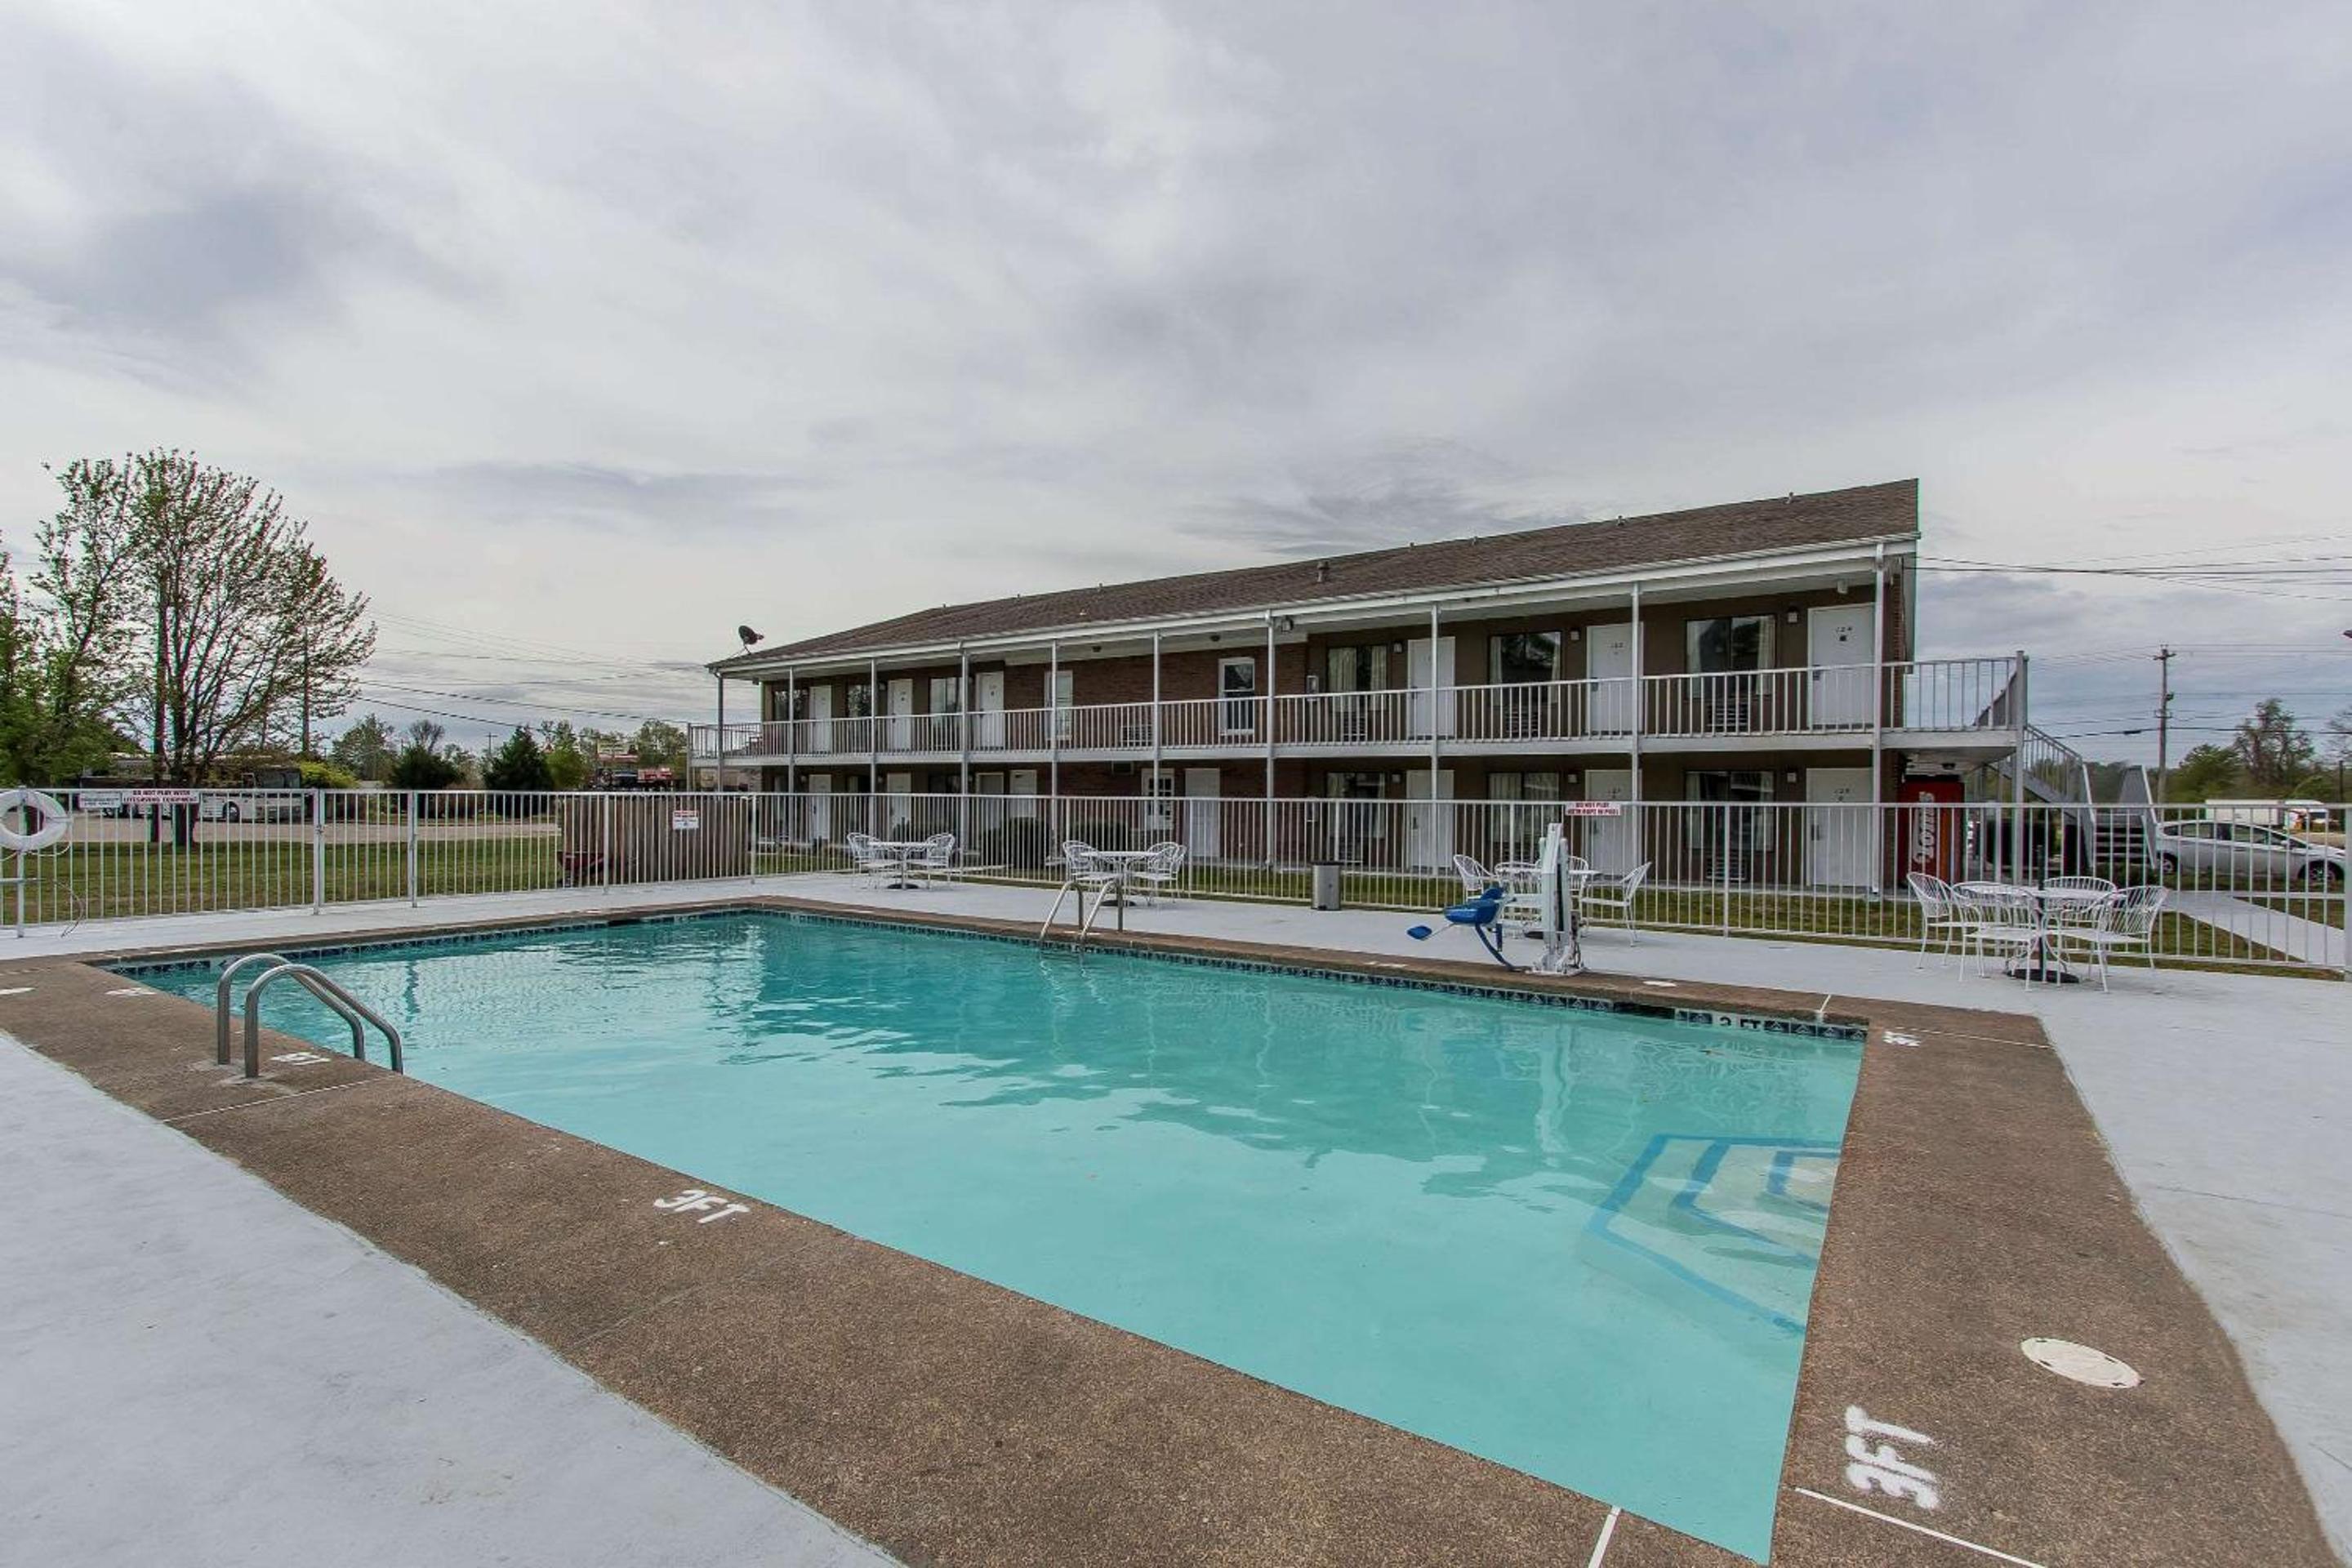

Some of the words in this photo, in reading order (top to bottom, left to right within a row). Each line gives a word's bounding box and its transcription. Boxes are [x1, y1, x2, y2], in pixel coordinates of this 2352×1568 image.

[1740, 1018, 1761, 1029] FT
[653, 1189, 751, 1224] 3FT
[1845, 1405, 1940, 1509] 3FT
